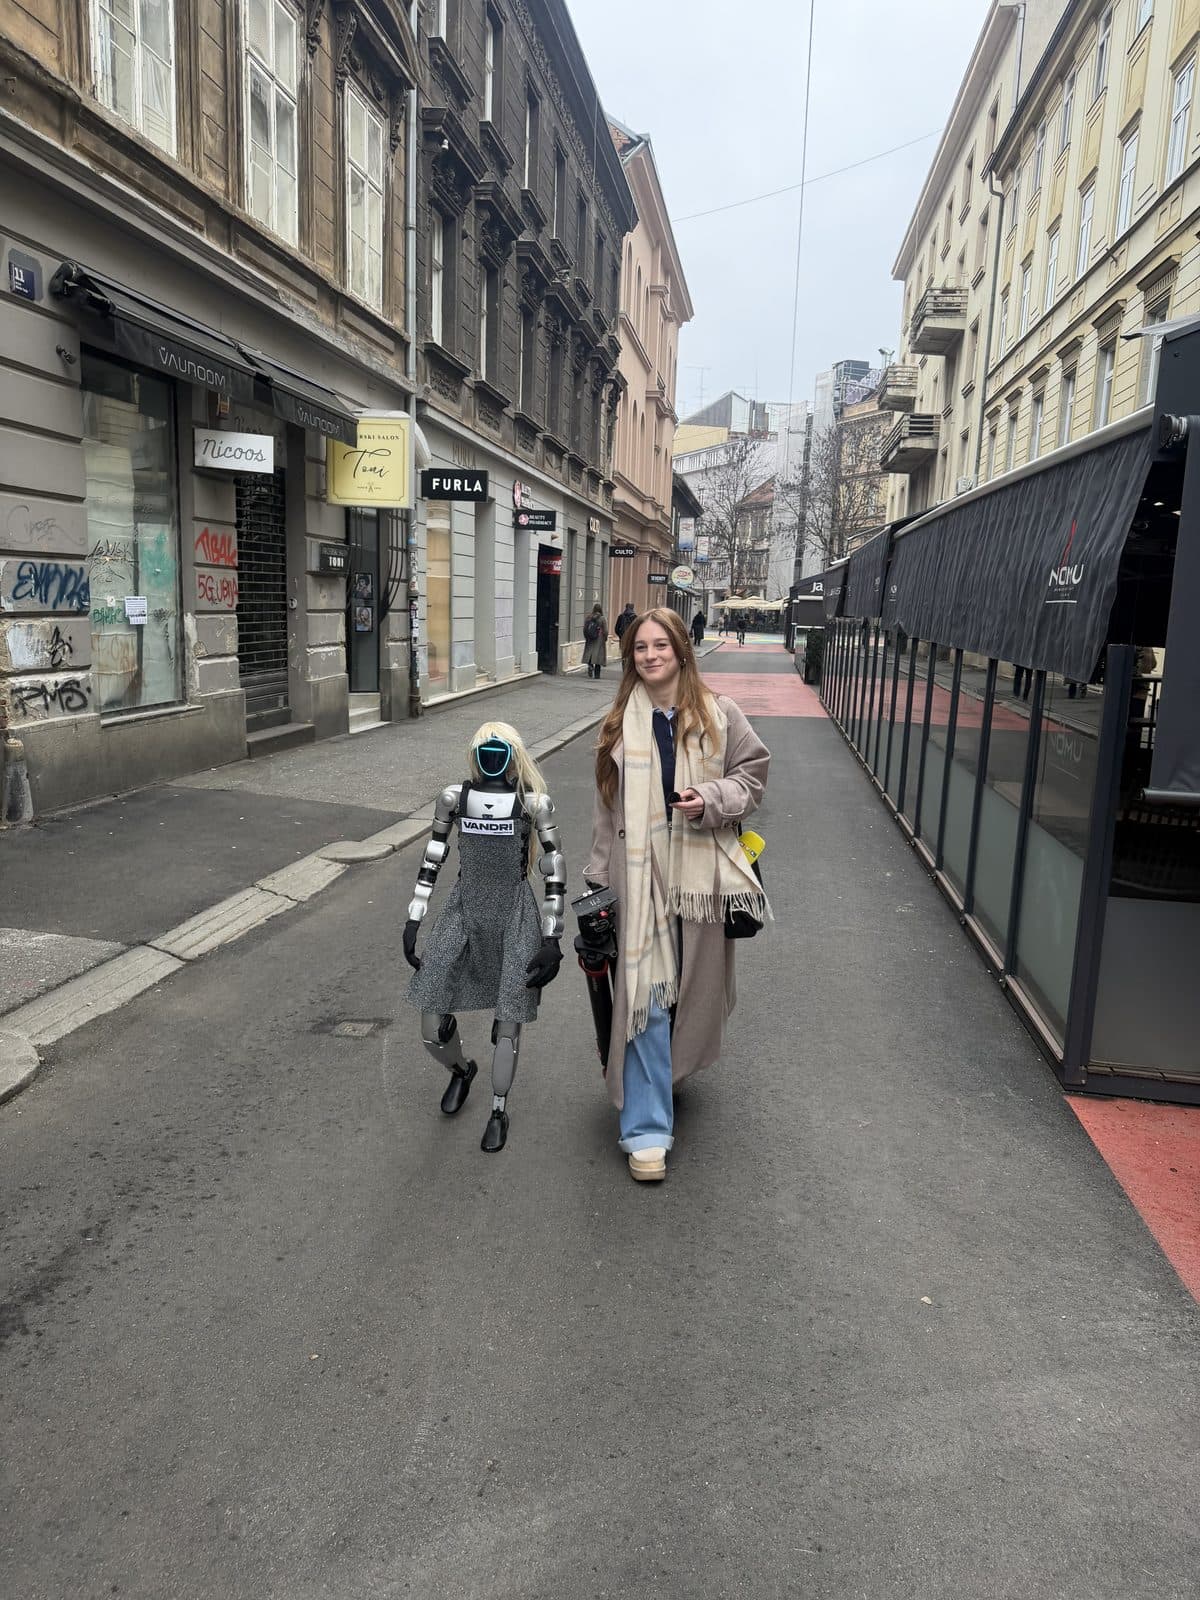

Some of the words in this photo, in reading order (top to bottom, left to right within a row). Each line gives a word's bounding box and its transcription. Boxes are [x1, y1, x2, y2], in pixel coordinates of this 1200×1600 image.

[14, 266, 25, 283] 11
[432, 478, 483, 492] FURLA
[463, 821, 513, 831] VANDRI
